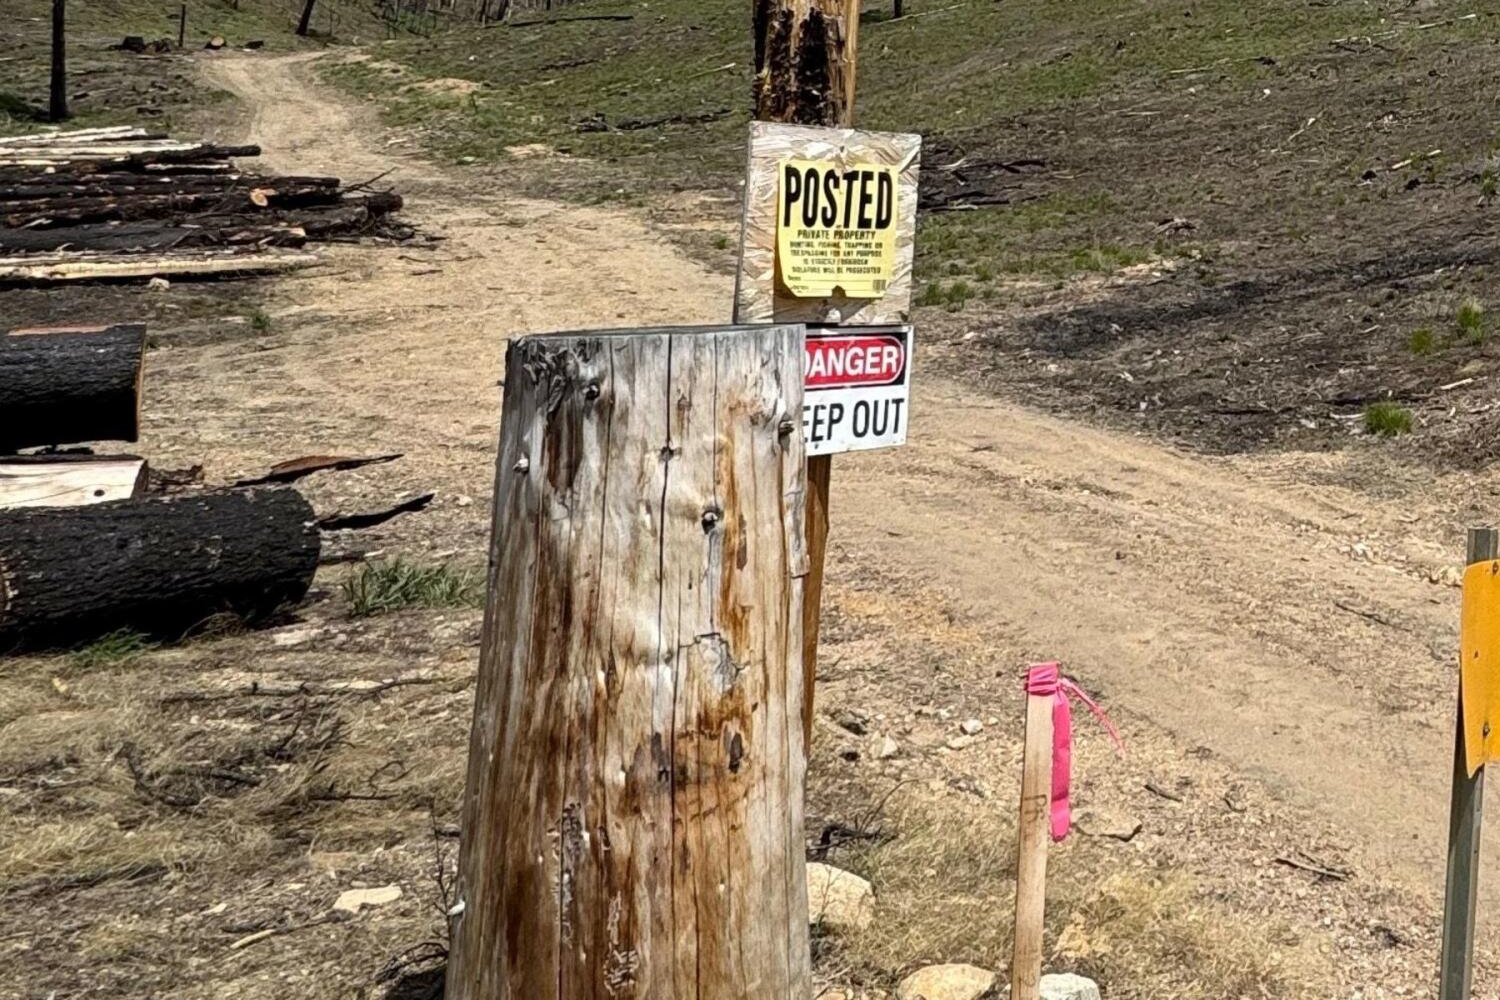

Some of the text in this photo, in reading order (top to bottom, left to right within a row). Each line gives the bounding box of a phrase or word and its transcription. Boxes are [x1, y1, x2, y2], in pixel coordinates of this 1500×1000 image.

[783, 166, 893, 229] POSTED
[797, 229, 876, 240] PRIVATE PROPERTY
[803, 398, 905, 443] EP OUT
